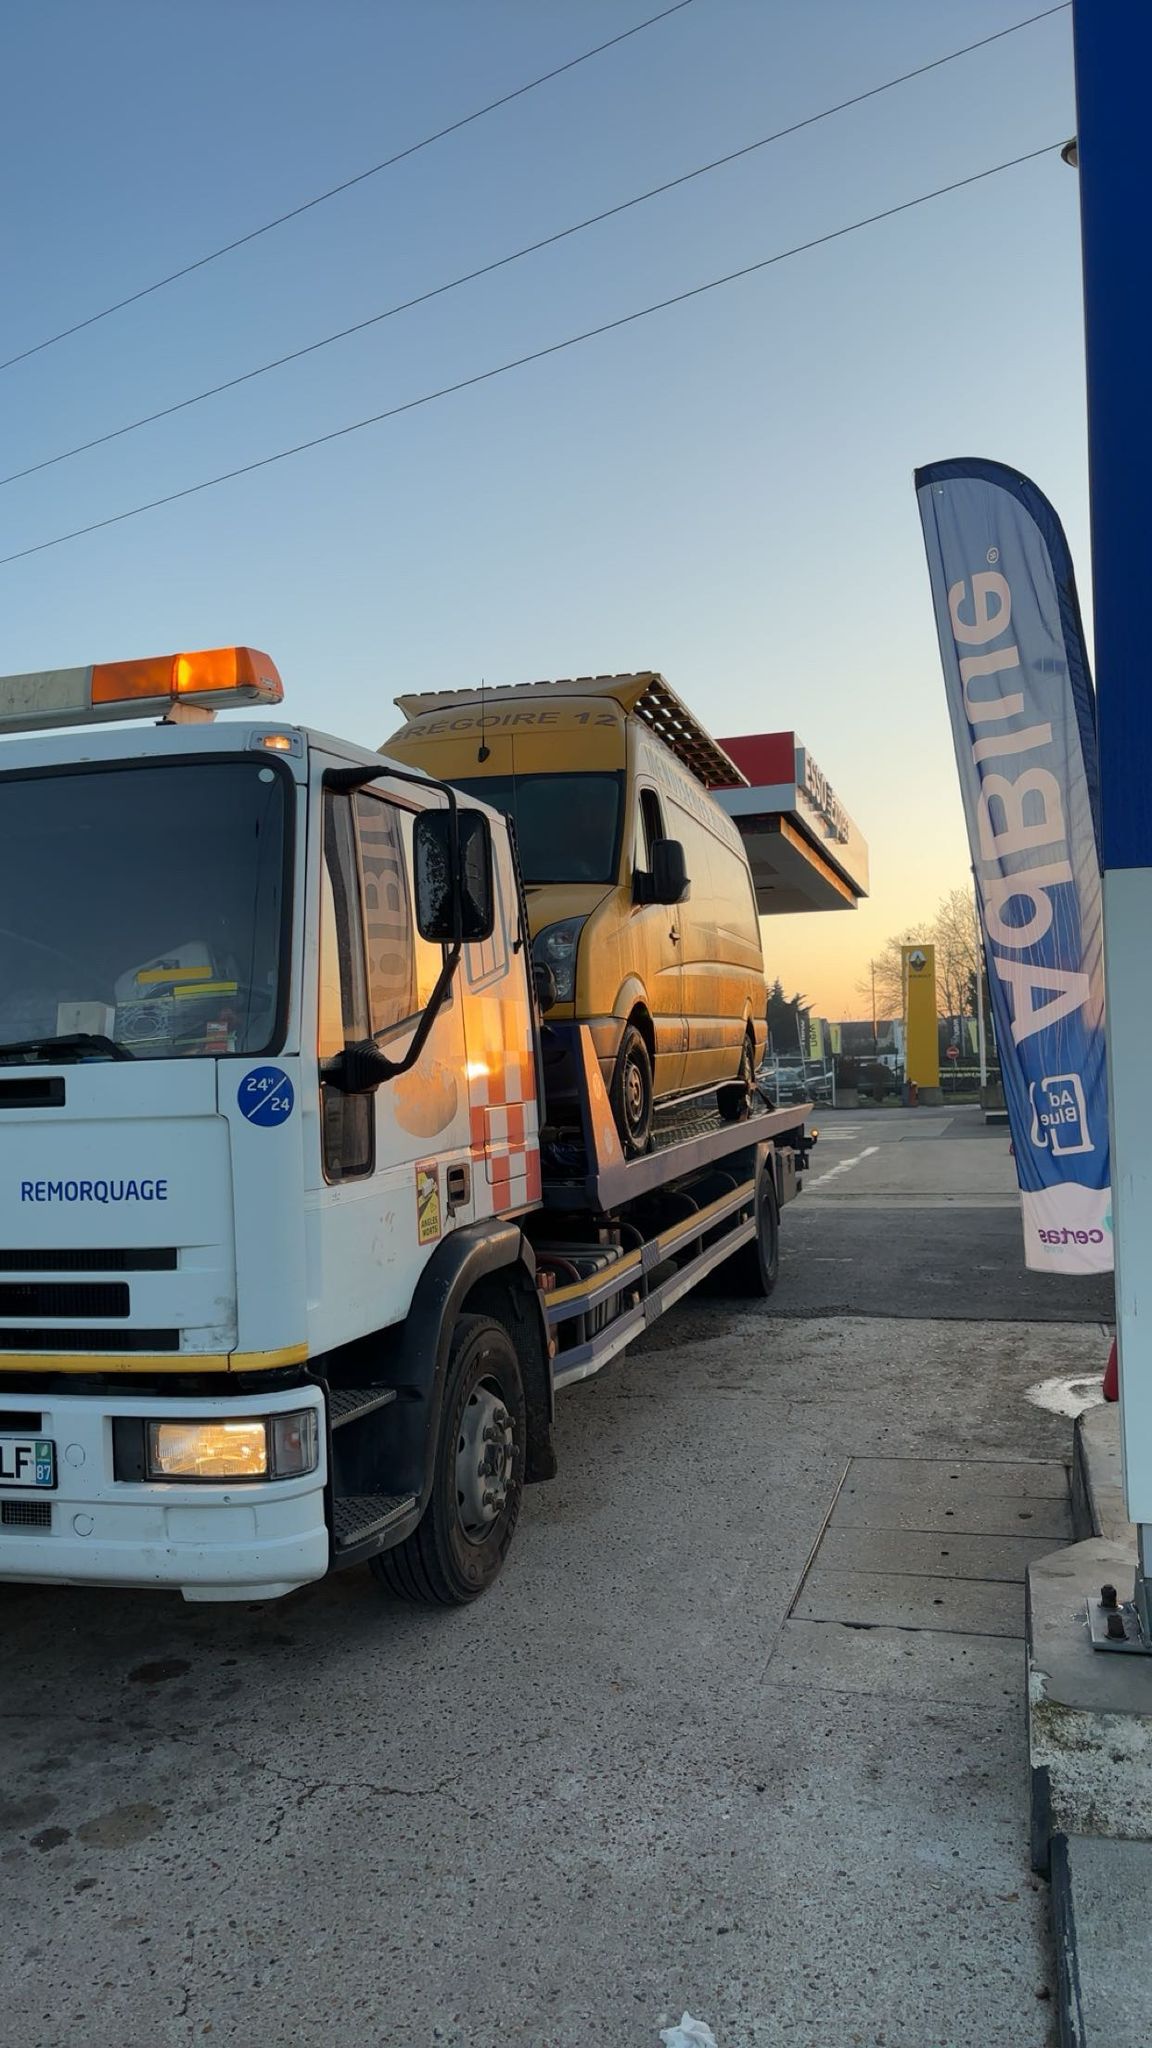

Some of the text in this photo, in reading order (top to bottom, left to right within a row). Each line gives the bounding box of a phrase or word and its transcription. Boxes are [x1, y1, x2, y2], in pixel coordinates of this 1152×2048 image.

[575, 712, 618, 727] 12
[271, 1098, 290, 1111] 24
[20, 1180, 168, 1203] REMORQUAGE
[36, 1464, 51, 1480] 87
